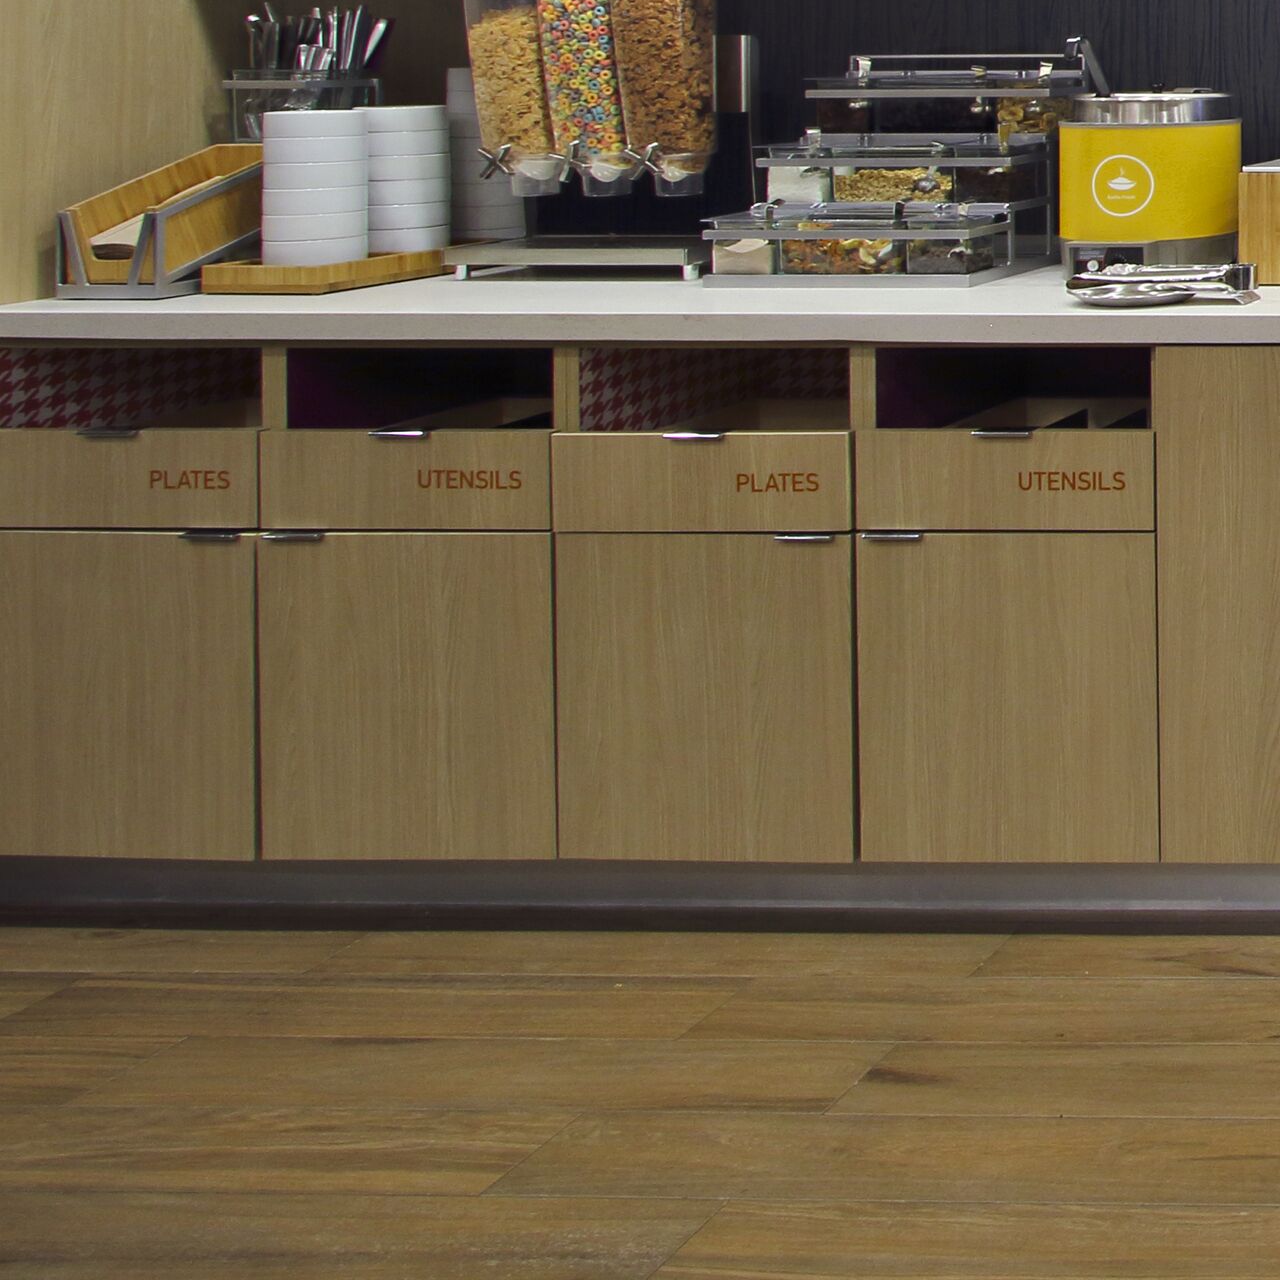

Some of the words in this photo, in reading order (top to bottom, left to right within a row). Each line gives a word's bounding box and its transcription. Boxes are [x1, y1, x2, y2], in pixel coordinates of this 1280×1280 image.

[148, 469, 231, 490] PLATES
[416, 469, 523, 490] UTENSILS
[735, 471, 820, 493] PLATES
[1017, 470, 1127, 492] UTENSILS
